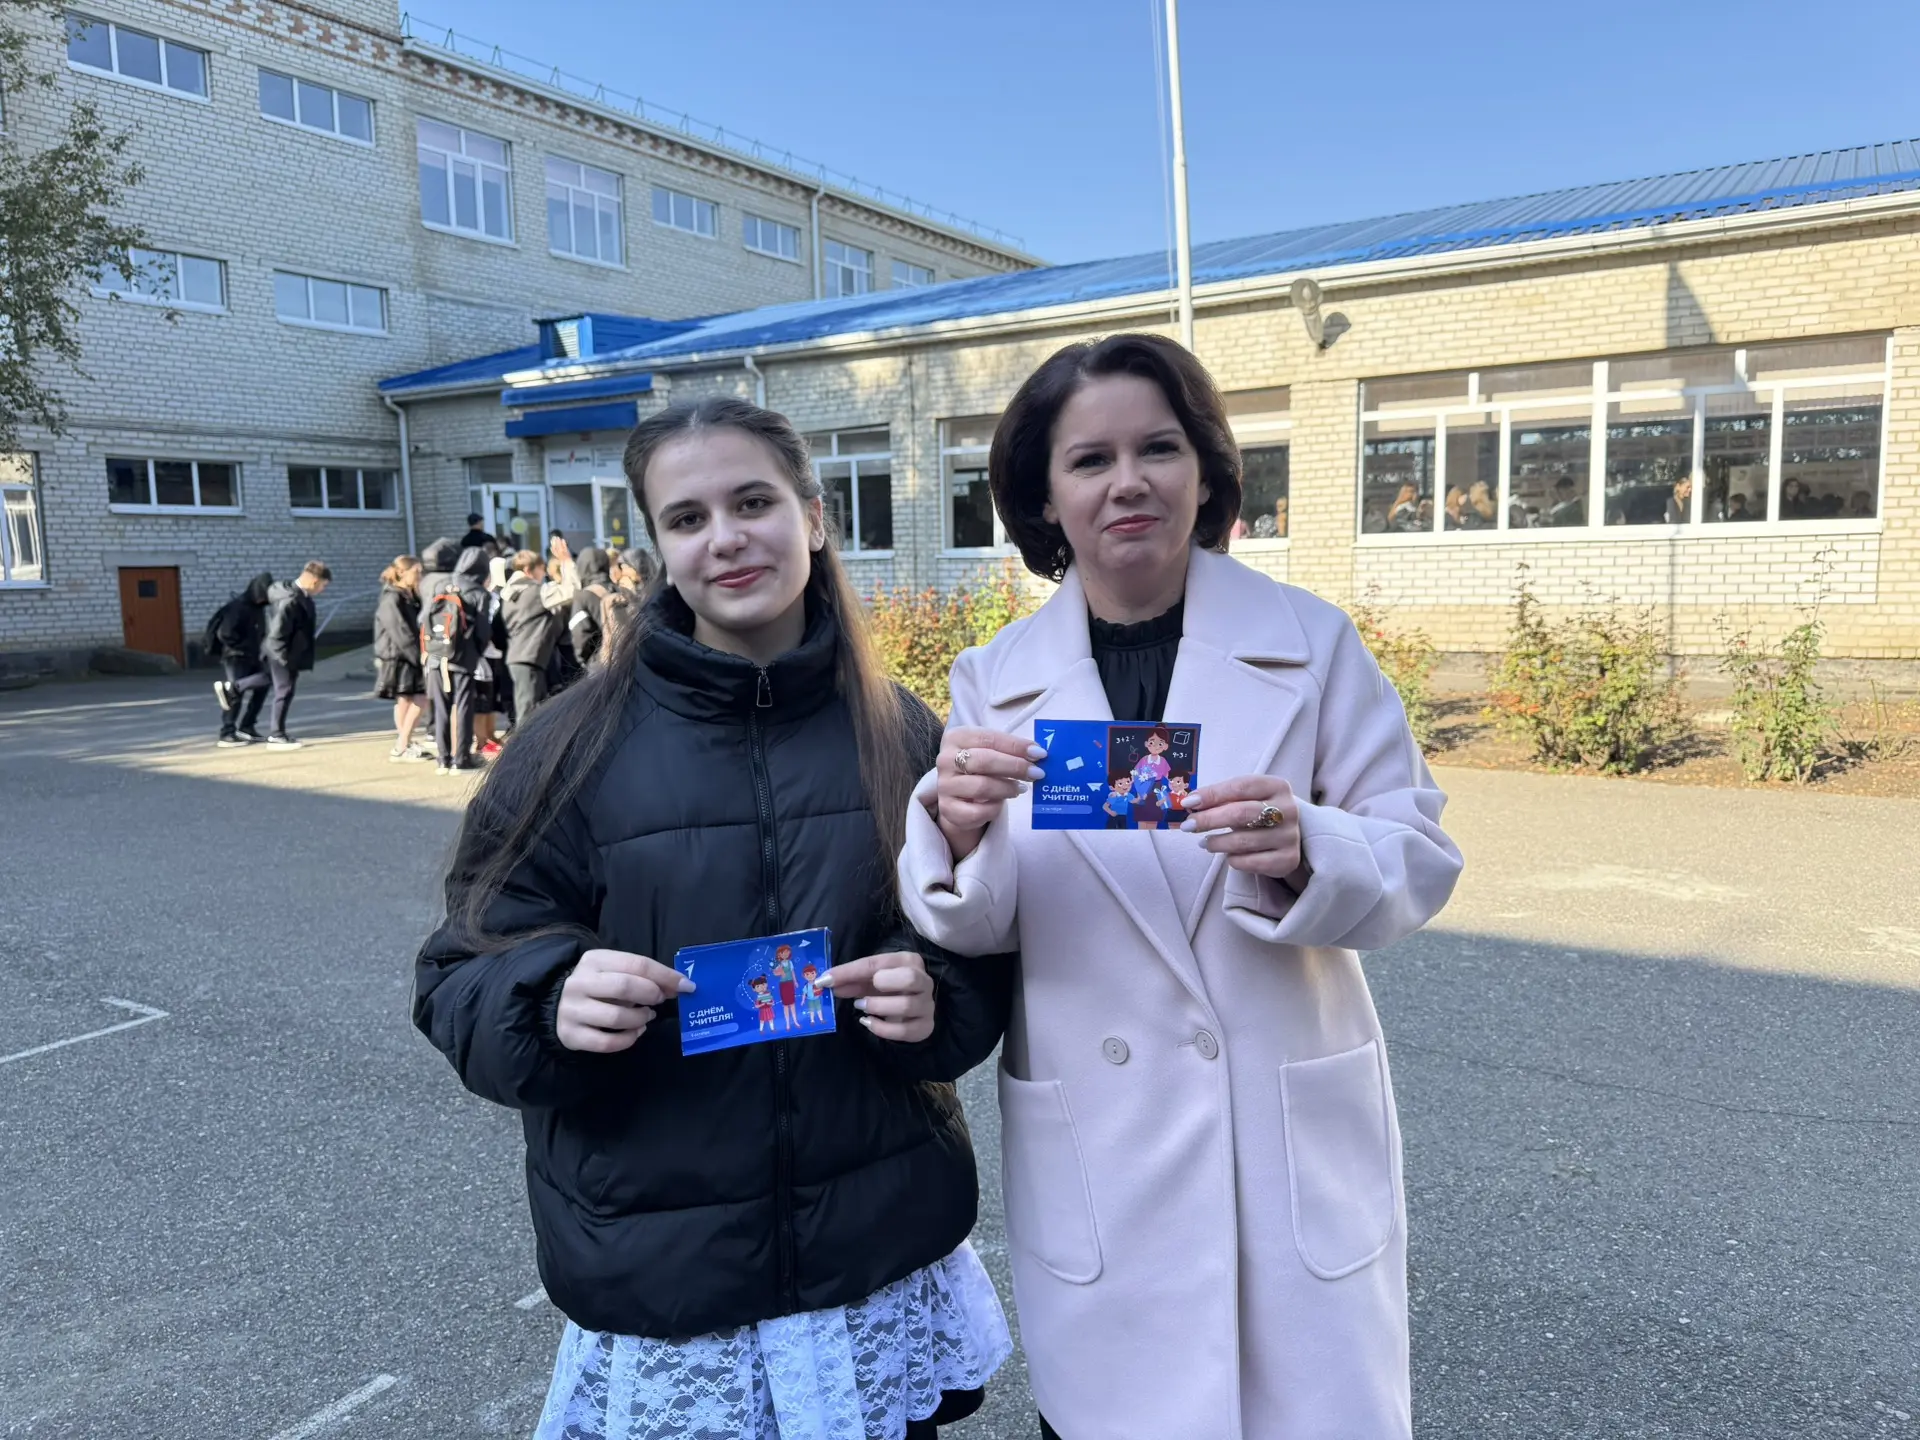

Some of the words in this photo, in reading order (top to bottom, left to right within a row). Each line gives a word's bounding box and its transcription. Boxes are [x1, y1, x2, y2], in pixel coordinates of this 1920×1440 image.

[1050, 784, 1081, 793] ДНЁМ
[697, 1006, 724, 1018] ДНЁМ
[689, 1013, 733, 1026] УЧИТЕЛЯ!
